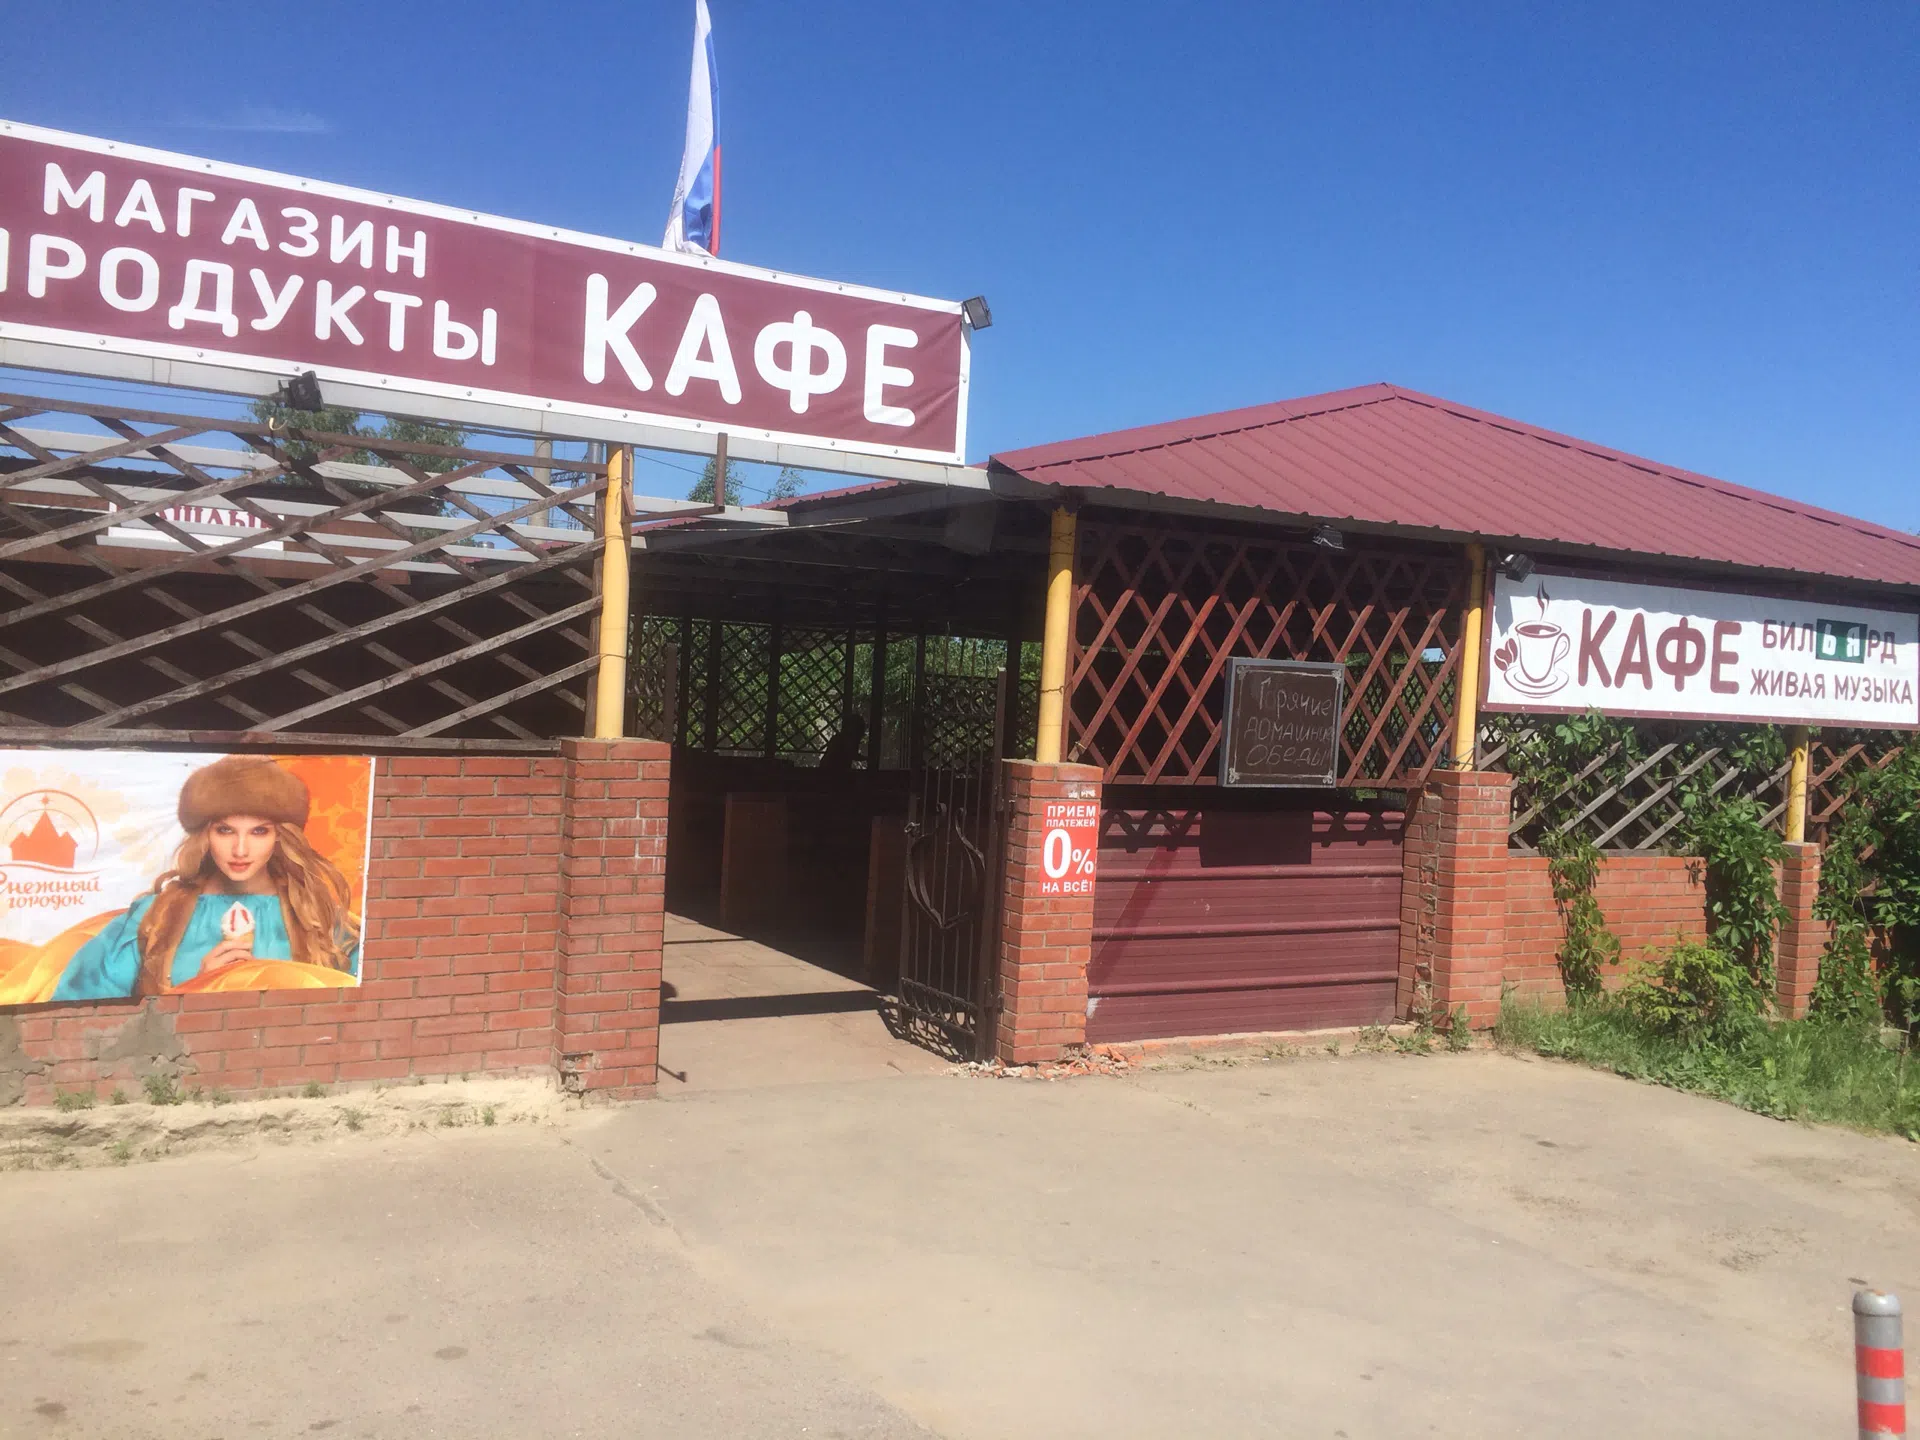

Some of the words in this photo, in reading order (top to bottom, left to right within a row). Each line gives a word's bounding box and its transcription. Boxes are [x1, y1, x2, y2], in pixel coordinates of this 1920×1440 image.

[44, 162, 427, 278] МАГАЗИН
[0, 228, 497, 367] РОДУКТЫ
[583, 273, 919, 427] КАФЕ
[1577, 608, 1742, 695] КАФЕ
[1762, 618, 1897, 664] БИЛЬЯРД
[1750, 668, 1826, 699] ЖИВАЯ
[1834, 674, 1914, 704] МУЗЫКА
[1046, 818, 1096, 827] ПЛАТЕЖЕЙ
[1047, 805, 1096, 817] ПРИЕМ
[1043, 828, 1094, 878] 0%
[1042, 882, 1060, 893] НА
[1063, 879, 1093, 893] ВСЁ!
